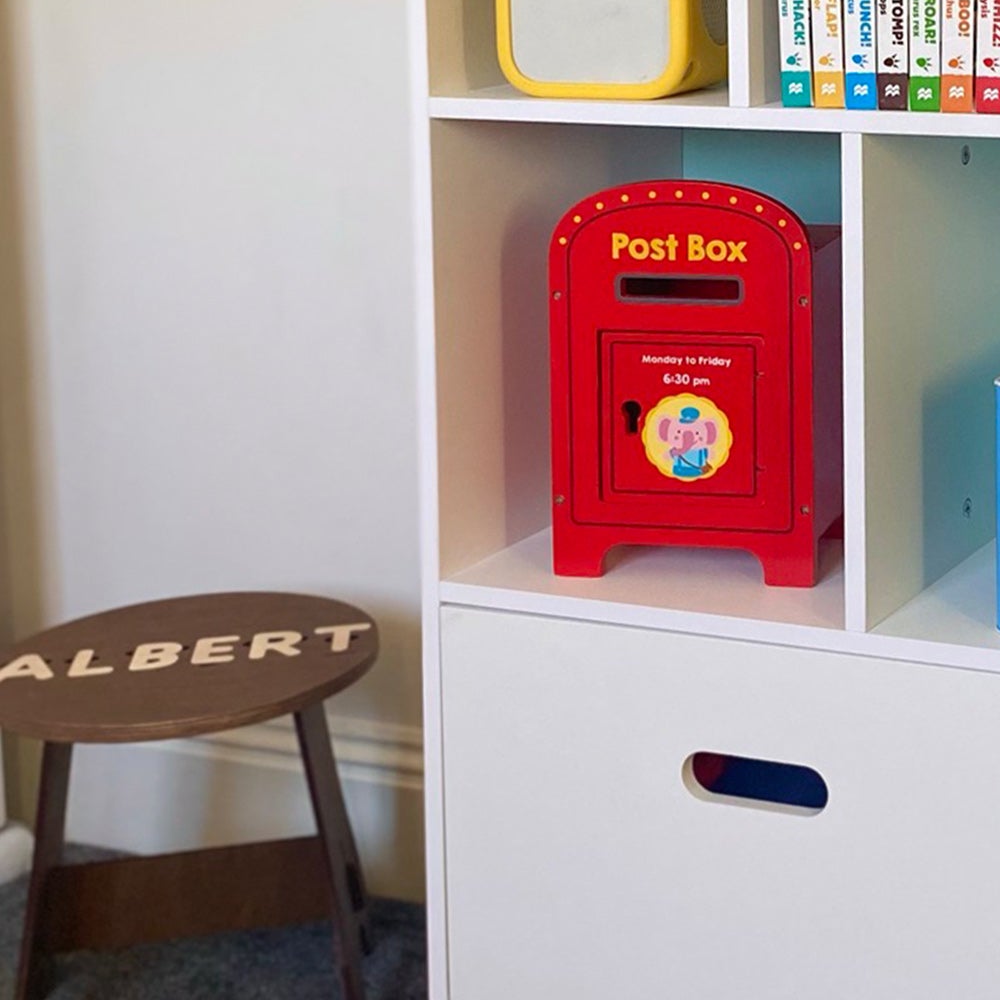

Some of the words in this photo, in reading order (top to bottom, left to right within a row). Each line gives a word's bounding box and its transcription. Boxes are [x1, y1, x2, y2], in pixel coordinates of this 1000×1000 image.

[612, 232, 678, 261] Post
[687, 234, 747, 262] Box
[642, 355, 683, 366] Monday
[685, 356, 697, 365] to
[698, 356, 731, 367] Friday
[663, 373, 690, 385] 6:30
[693, 377, 711, 387] pm
[0, 623, 371, 681] ALBERT
